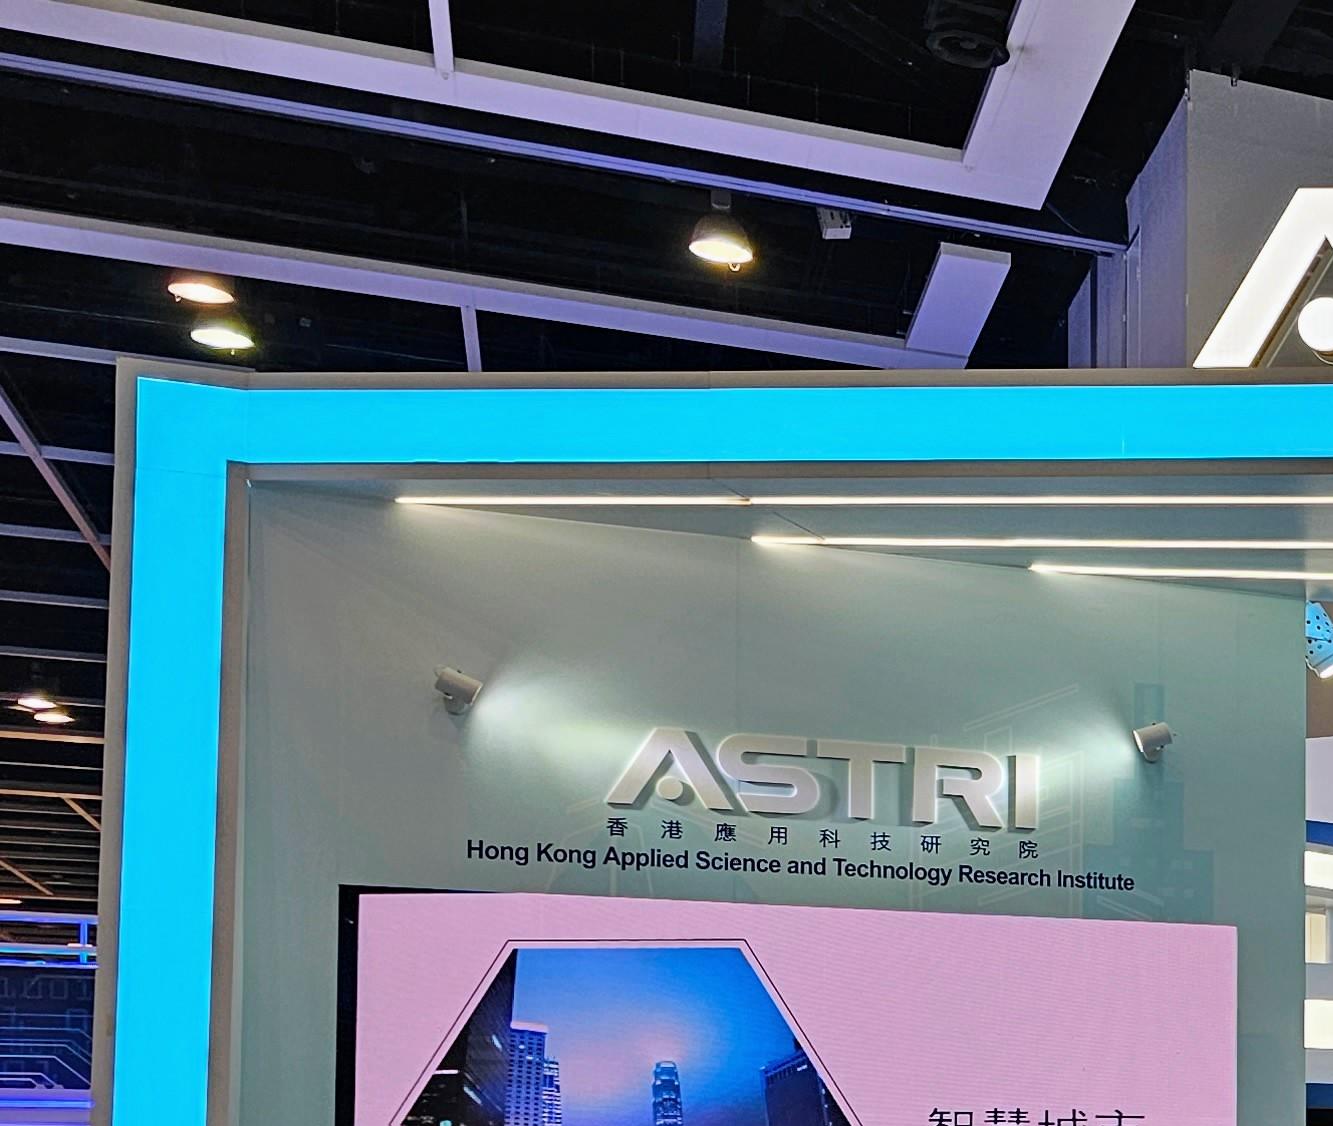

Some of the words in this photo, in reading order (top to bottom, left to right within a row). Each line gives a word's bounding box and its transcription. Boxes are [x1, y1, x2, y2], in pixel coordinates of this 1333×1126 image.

[606, 726, 1040, 832] ASTRI
[606, 816, 1040, 860] 香港應用科技研究院
[466, 839, 529, 867] Hong
[535, 842, 597, 871] Kong
[603, 845, 689, 873] Applied
[695, 850, 782, 875] Science
[788, 854, 826, 877] and
[833, 857, 952, 886] Technology
[958, 863, 1050, 889] Research
[1056, 867, 1136, 891] Institute
